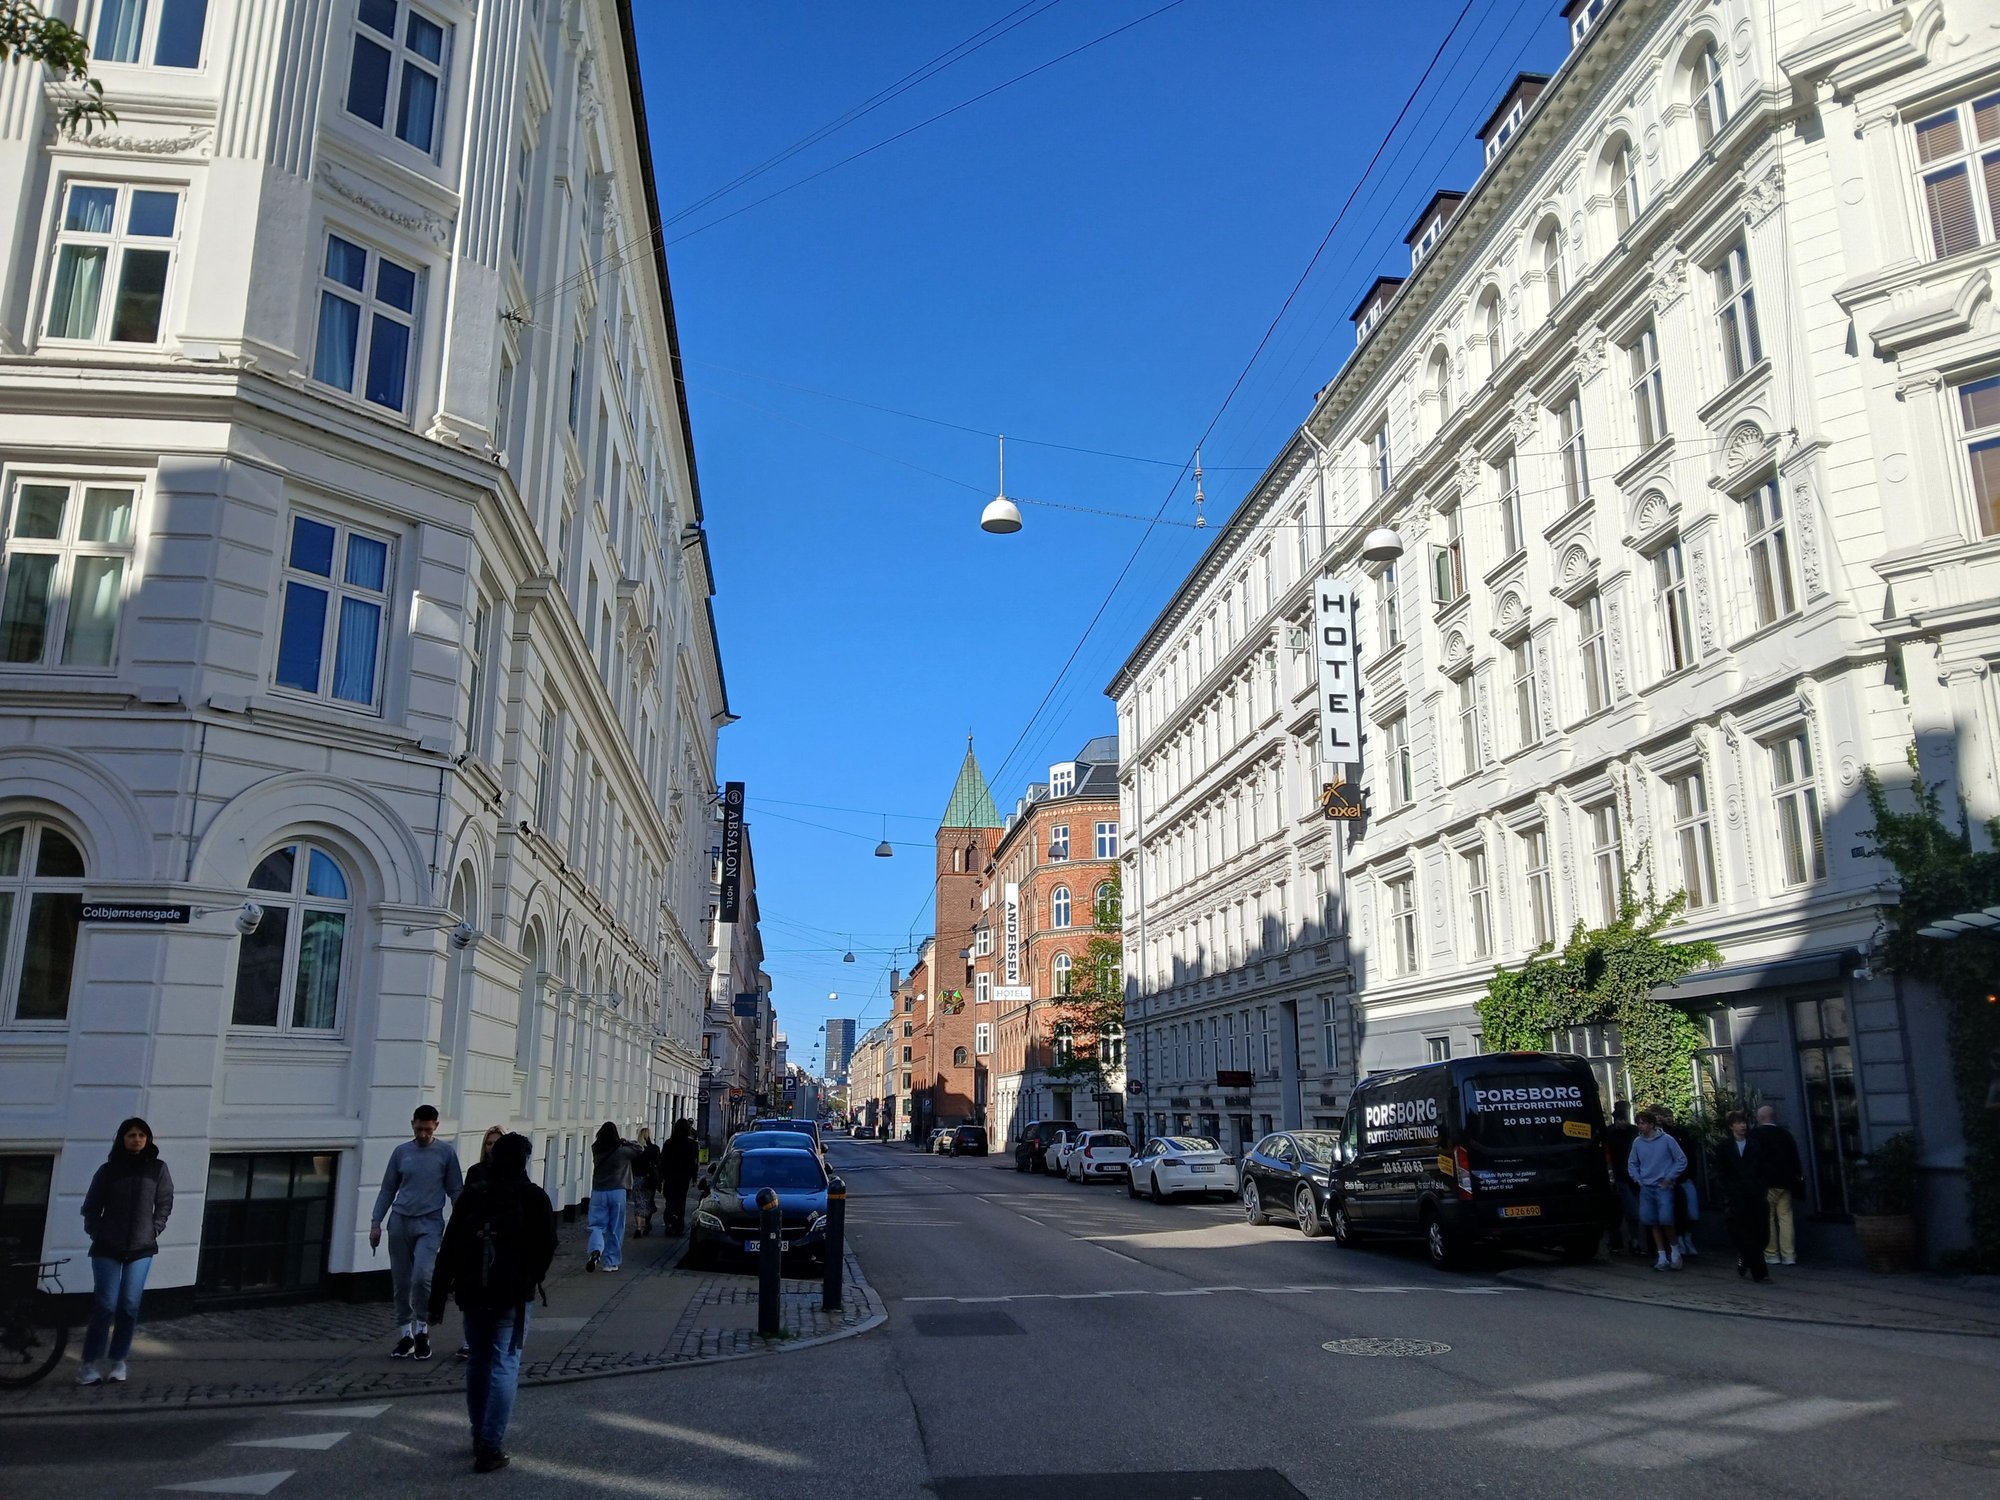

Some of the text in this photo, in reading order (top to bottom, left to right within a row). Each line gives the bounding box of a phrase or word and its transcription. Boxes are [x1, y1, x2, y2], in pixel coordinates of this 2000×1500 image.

[1323, 593, 1350, 747] HOTEL
[1328, 803, 1362, 818] axel
[726, 810, 739, 909] ABSALON HOTEL
[82, 906, 181, 921] Colbjørnsensgade
[1007, 901, 1017, 981] ANDERSEN
[1475, 1086, 1581, 1102] PORSBORG
[1365, 1098, 1438, 1128] PORSBORG
[1477, 1100, 1583, 1112] FLYTTEFORRETNING
[1503, 1115, 1562, 1126] 20 83 20 83
[1367, 1125, 1439, 1144] FLYTTEFORRETNING
[1382, 1160, 1424, 1174] 20 83 20 83
